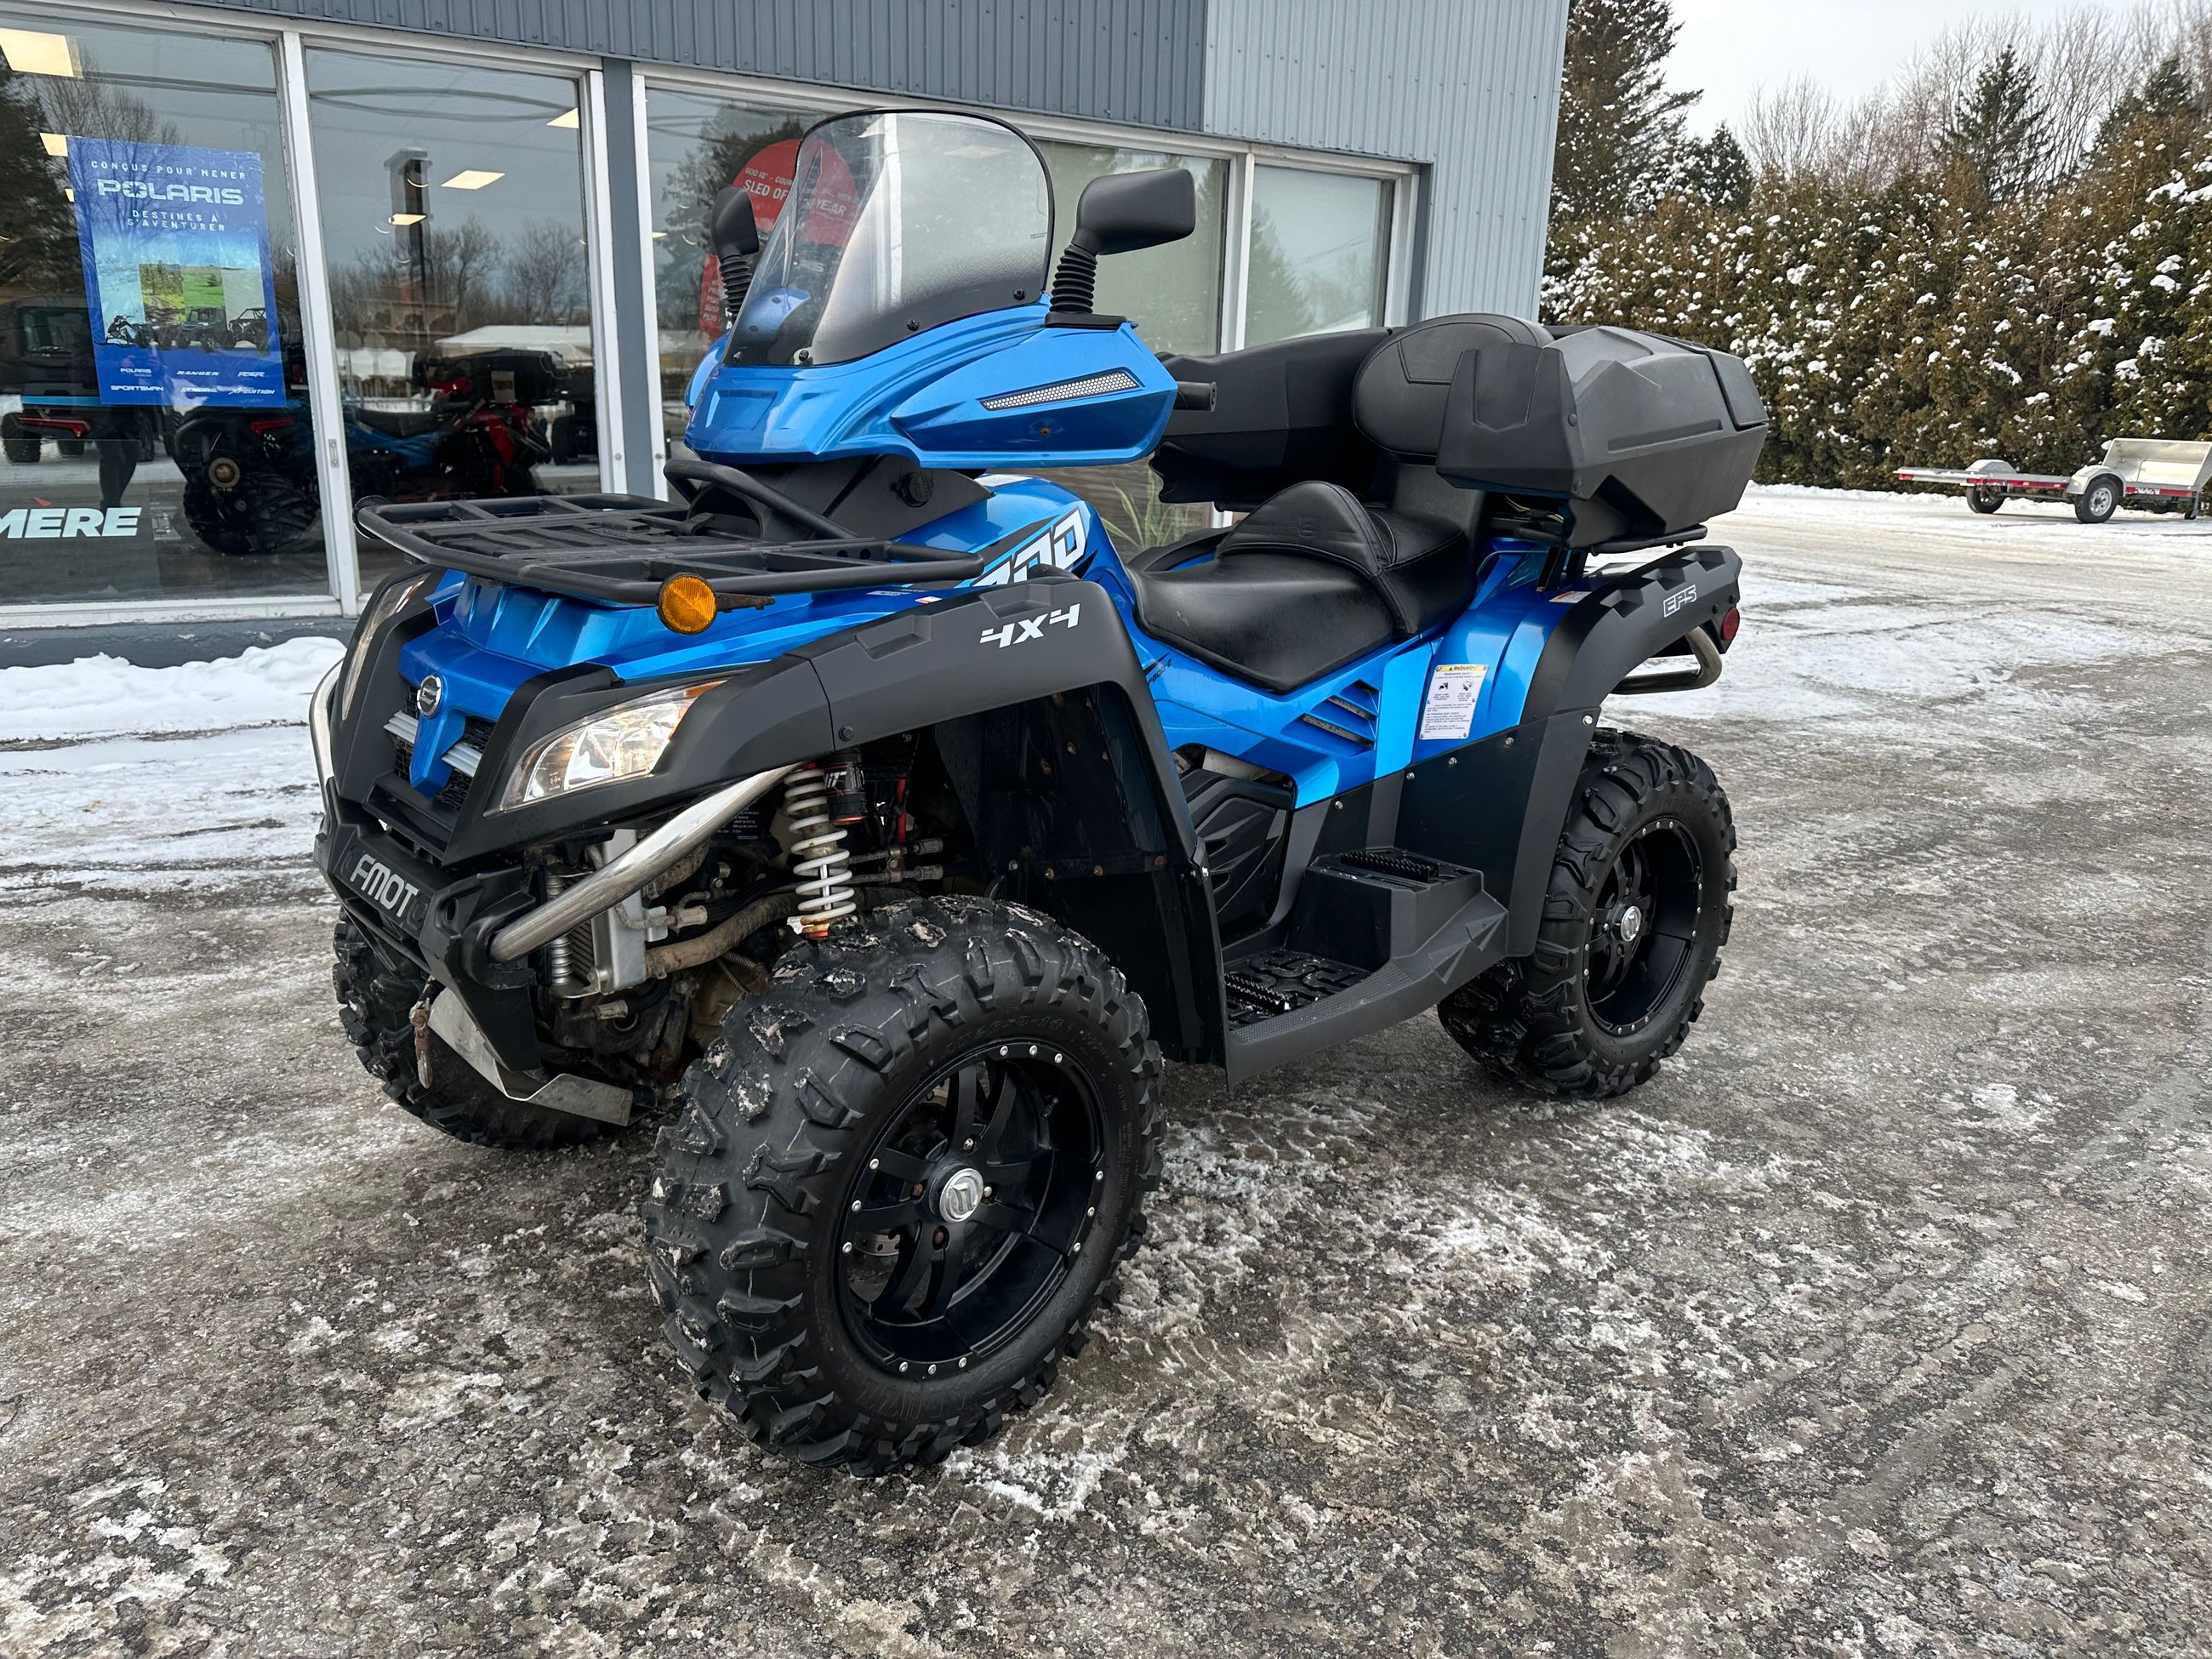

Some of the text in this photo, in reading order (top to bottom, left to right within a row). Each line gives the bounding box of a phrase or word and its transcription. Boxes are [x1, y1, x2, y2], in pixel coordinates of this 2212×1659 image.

[91, 160, 246, 180] CONÇUS POUR MENER
[97, 179, 244, 205] POLARIS
[743, 180, 790, 202] SLED OF
[127, 218, 225, 231] S'AVENTURER
[972, 510, 1086, 587] 00
[1663, 584, 1697, 618] EPS
